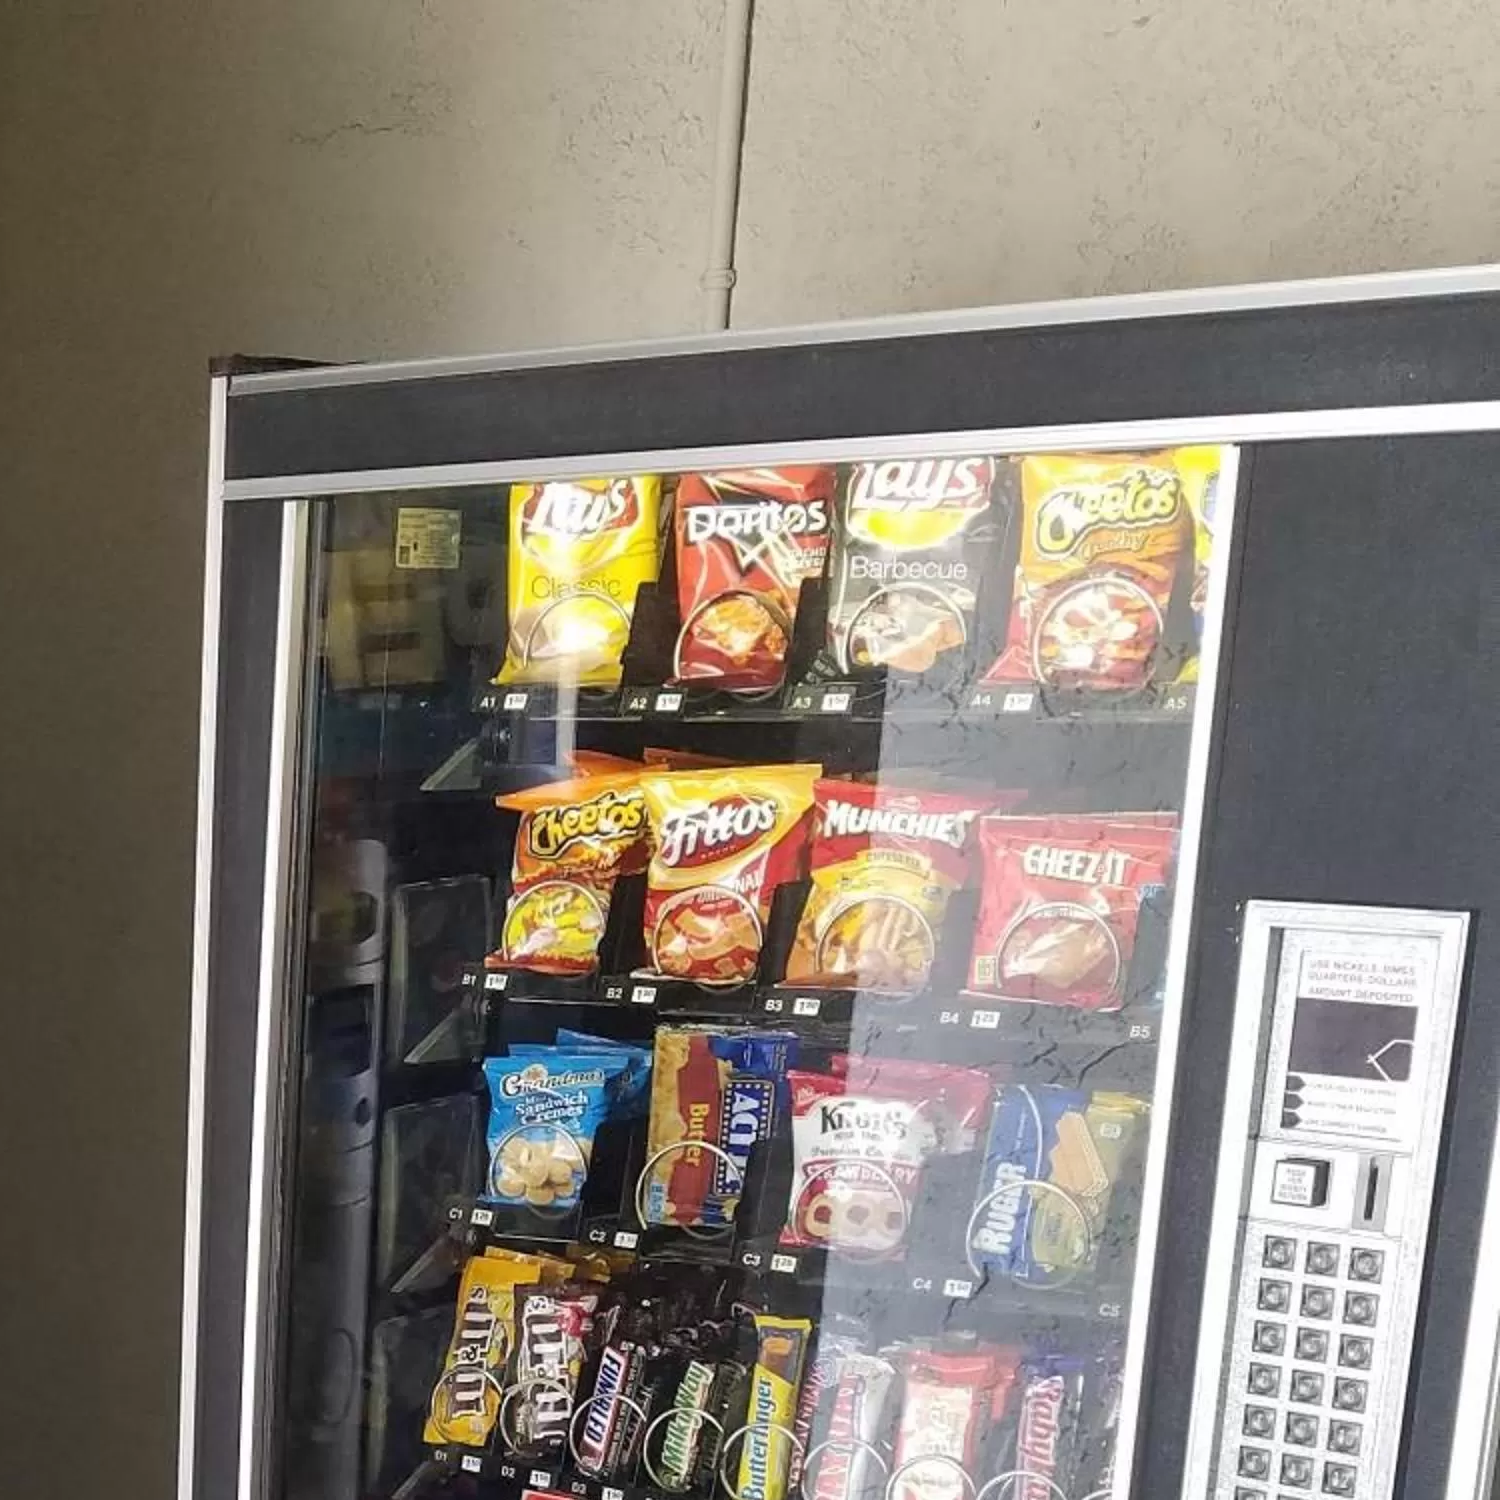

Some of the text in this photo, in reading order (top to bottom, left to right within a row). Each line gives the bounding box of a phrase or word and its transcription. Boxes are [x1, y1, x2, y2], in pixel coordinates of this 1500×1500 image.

[687, 500, 828, 542] Doritos
[849, 556, 968, 580] Barbecue
[531, 575, 621, 599] Classic
[480, 696, 496, 709] A1
[630, 697, 648, 710] A2
[793, 697, 811, 709] A3
[971, 695, 991, 706] A4
[531, 797, 643, 856] Cheetos
[823, 799, 976, 848] MUNCHIES
[661, 799, 776, 867] Fritos
[1023, 843, 1130, 885] CHEEZ-IT
[461, 974, 477, 986] B1
[606, 987, 623, 999] B2
[764, 1000, 783, 1012] B3
[940, 1012, 959, 1024] B4
[1129, 1025, 1151, 1038] B5
[515, 1089, 588, 1115] Sandwich
[589, 1230, 606, 1242] C2
[743, 1253, 761, 1266] C3
[913, 1278, 932, 1291] C4
[662, 1361, 712, 1476] Milky Way
[501, 1466, 515, 1478] D2
